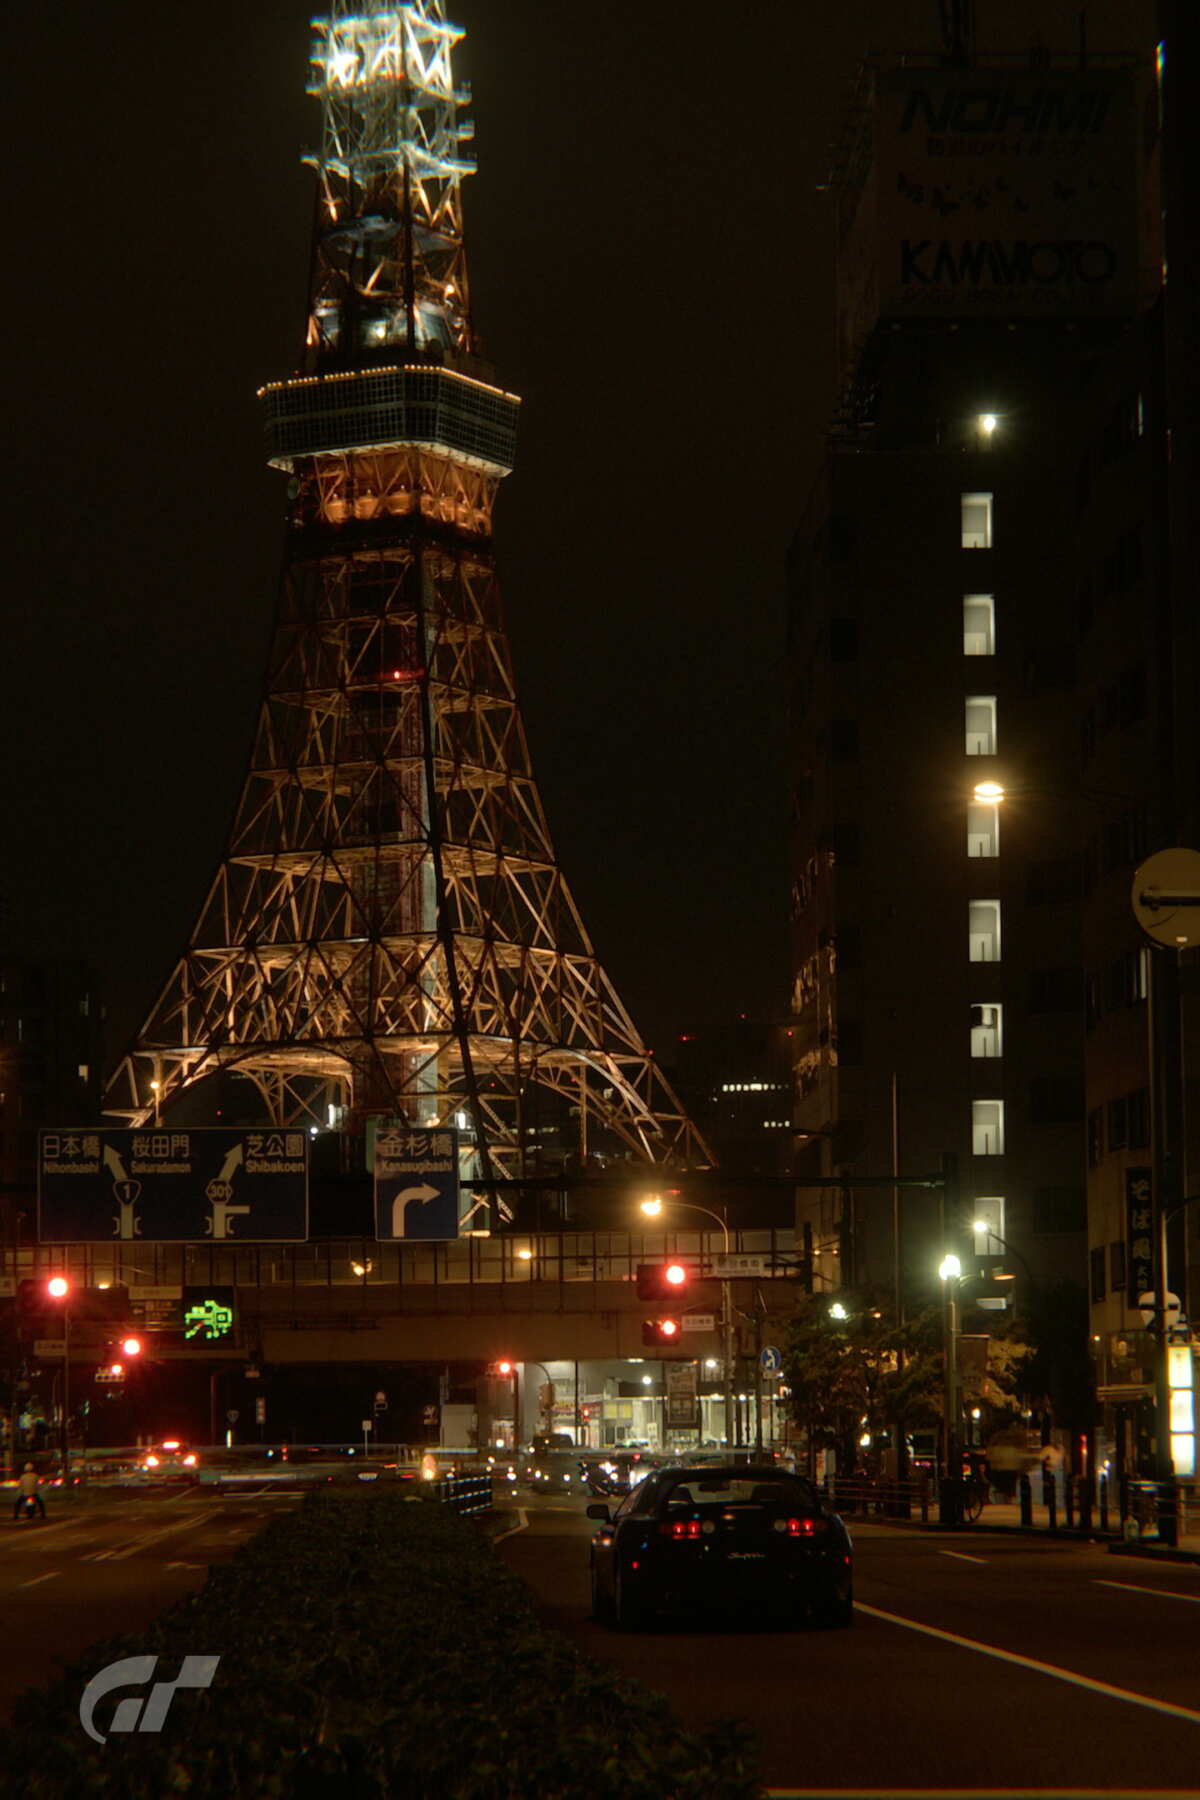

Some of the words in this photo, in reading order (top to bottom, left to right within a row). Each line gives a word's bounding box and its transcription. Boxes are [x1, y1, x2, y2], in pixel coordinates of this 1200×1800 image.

[897, 88, 1116, 134] NOHMI
[42, 1135, 100, 1158] 日本橋
[131, 1135, 190, 1158] 桜田門
[245, 1134, 304, 1157] 芝公園
[381, 1133, 453, 1157] 金杉橋
[245, 1160, 305, 1174] Shibakoen
[123, 1183, 131, 1199] 1
[210, 1184, 230, 1198] 301
